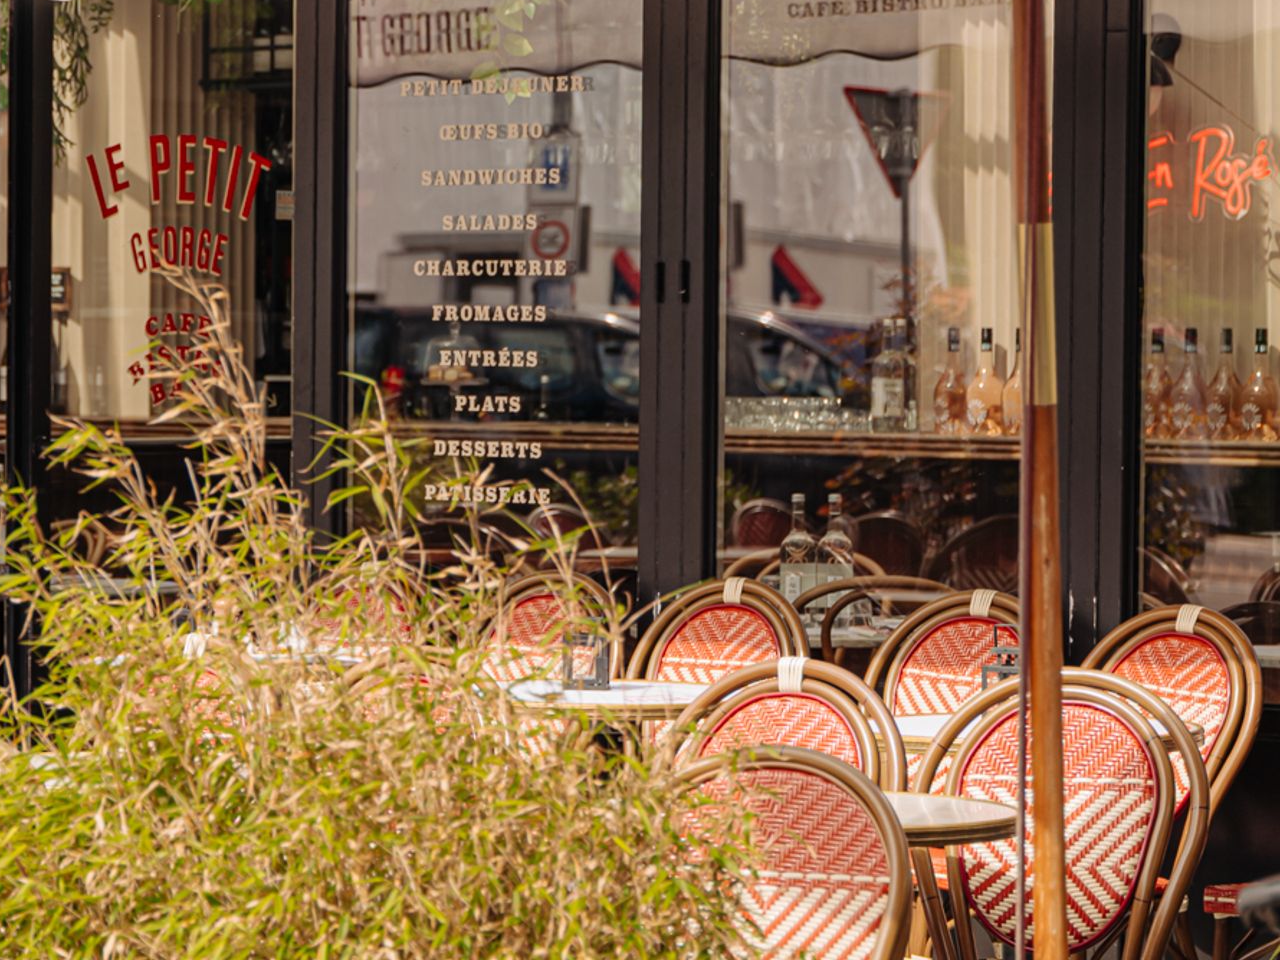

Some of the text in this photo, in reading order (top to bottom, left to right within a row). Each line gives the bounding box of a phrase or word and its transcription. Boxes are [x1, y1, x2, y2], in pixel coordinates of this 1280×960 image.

[507, 123, 544, 139] BIO
[86, 134, 272, 221] LE PETIT
[421, 167, 561, 186] SANDWICHES
[442, 214, 538, 231] SALADES
[130, 226, 229, 276] GEORGE
[413, 259, 567, 277] CHARCUTERIE
[432, 304, 547, 322] FROMAGES
[439, 347, 538, 368] ENTRÉES
[455, 395, 522, 413] PLATS
[433, 440, 543, 459] DESSERTS
